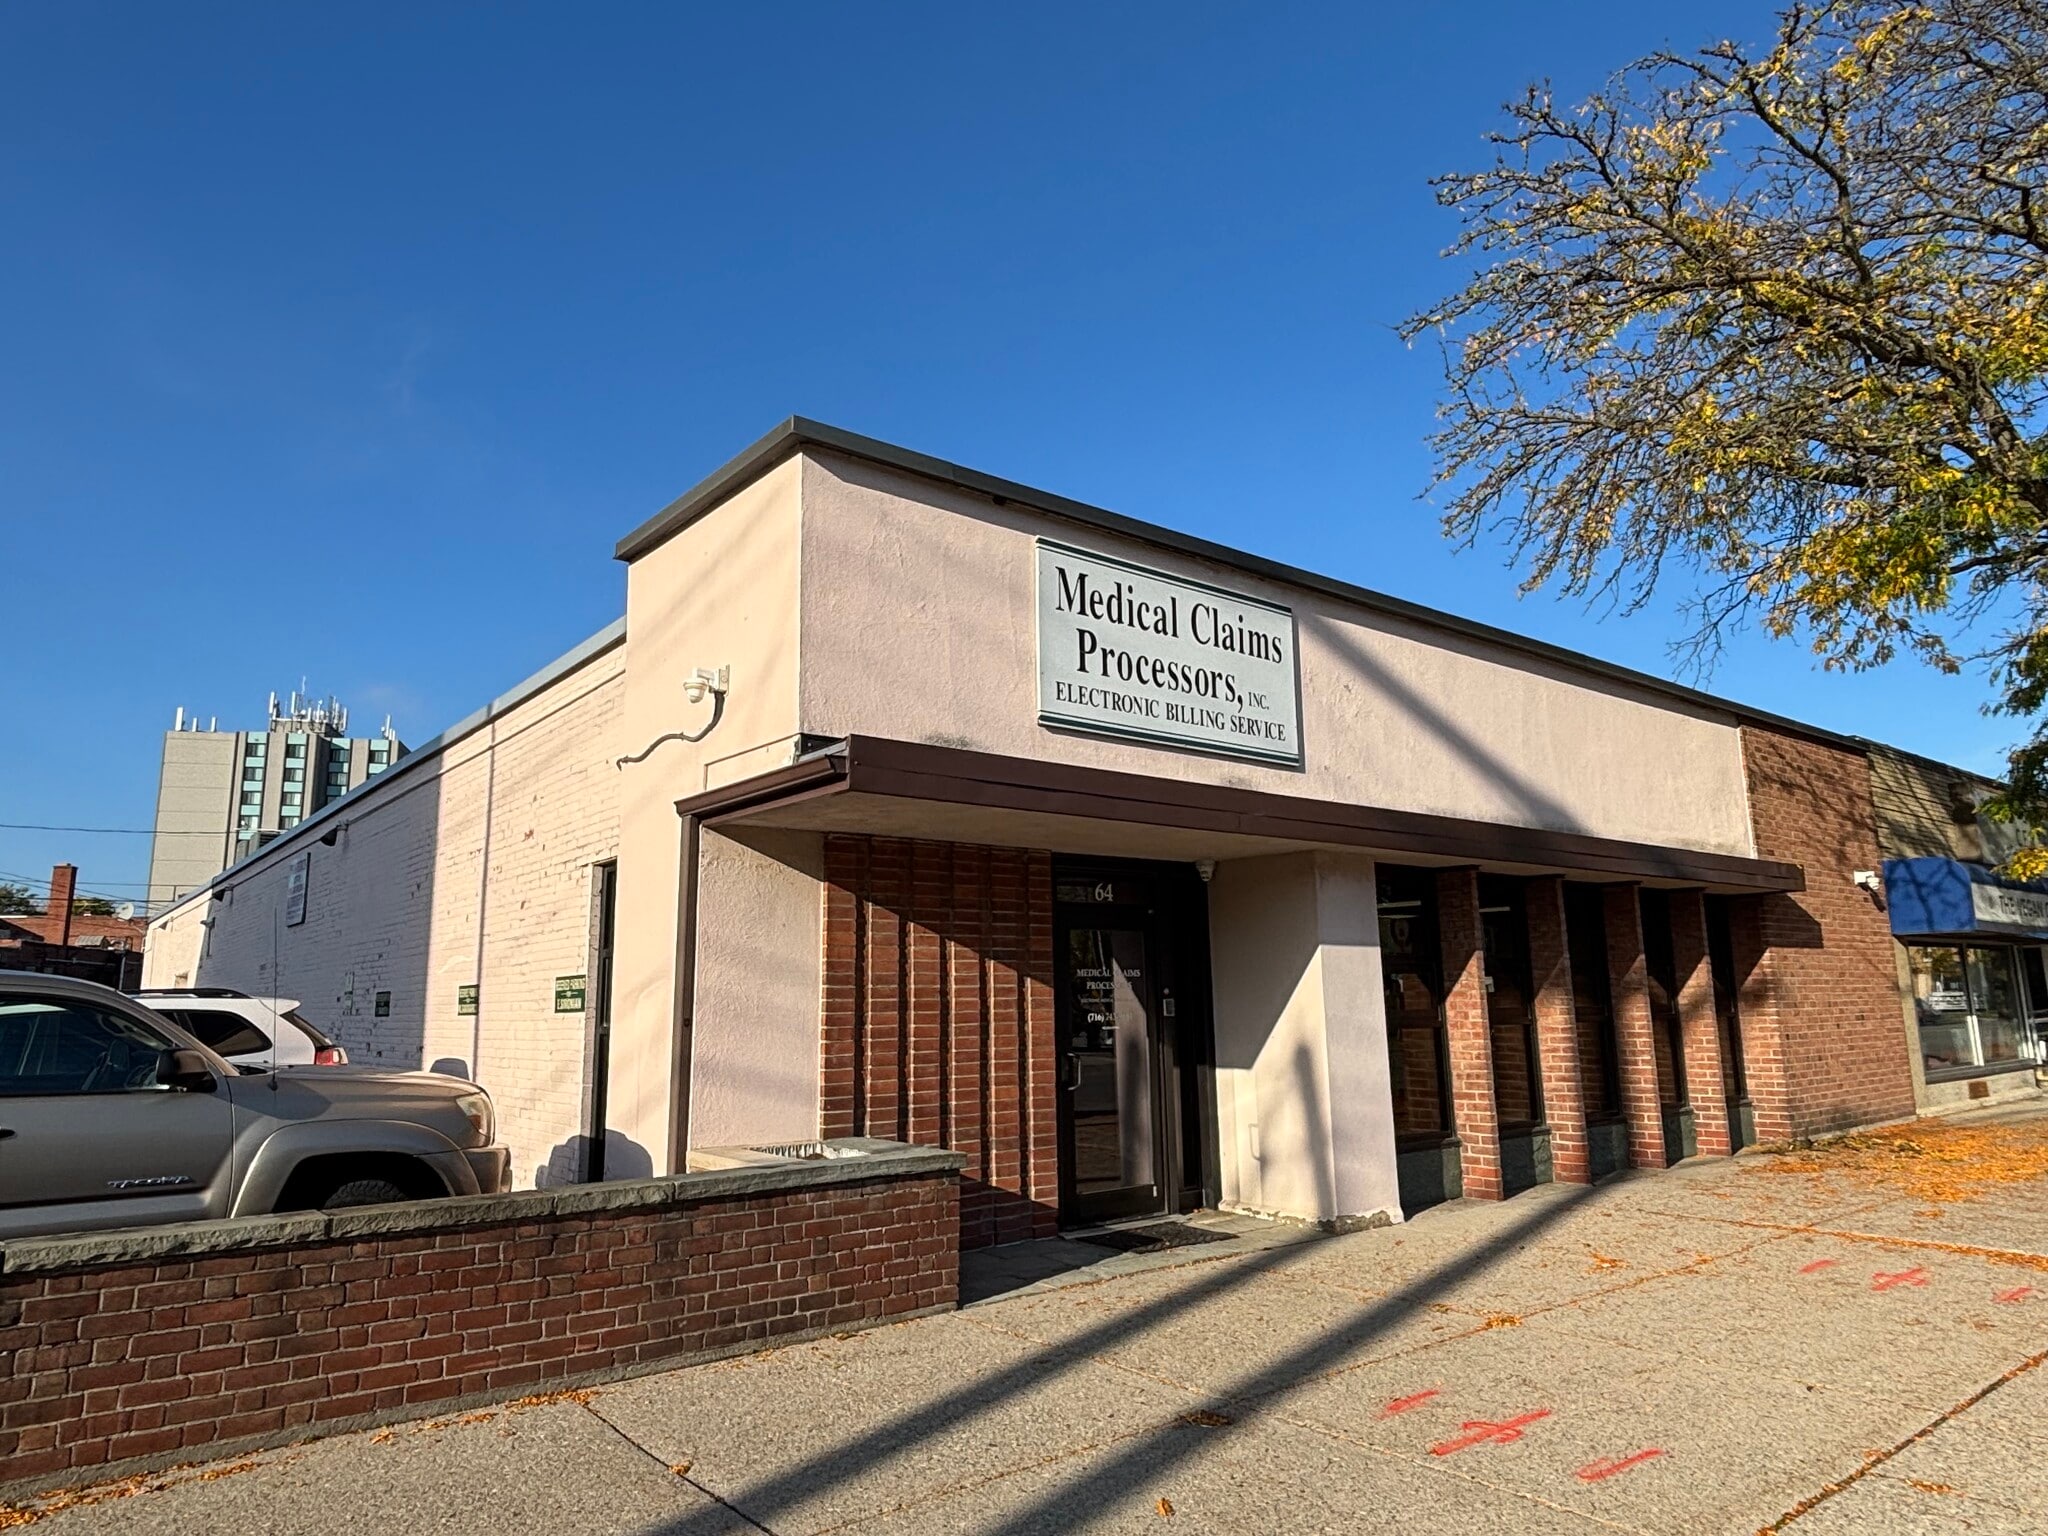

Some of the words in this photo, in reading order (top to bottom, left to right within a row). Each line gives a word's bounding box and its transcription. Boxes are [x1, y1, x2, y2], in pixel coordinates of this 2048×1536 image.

[1055, 566, 1179, 638] Medical
[1191, 603, 1282, 663] Claims
[1076, 628, 1243, 713] Processors,
[1248, 691, 1270, 710] INC.
[1055, 681, 1160, 718] ELECTRONIC
[1166, 703, 1225, 730] BILLING
[1230, 715, 1286, 741] SERVICE
[1095, 883, 1113, 901] 64
[1076, 968, 1111, 977] MEDICAL
[107, 1176, 190, 1188] TACOMA
